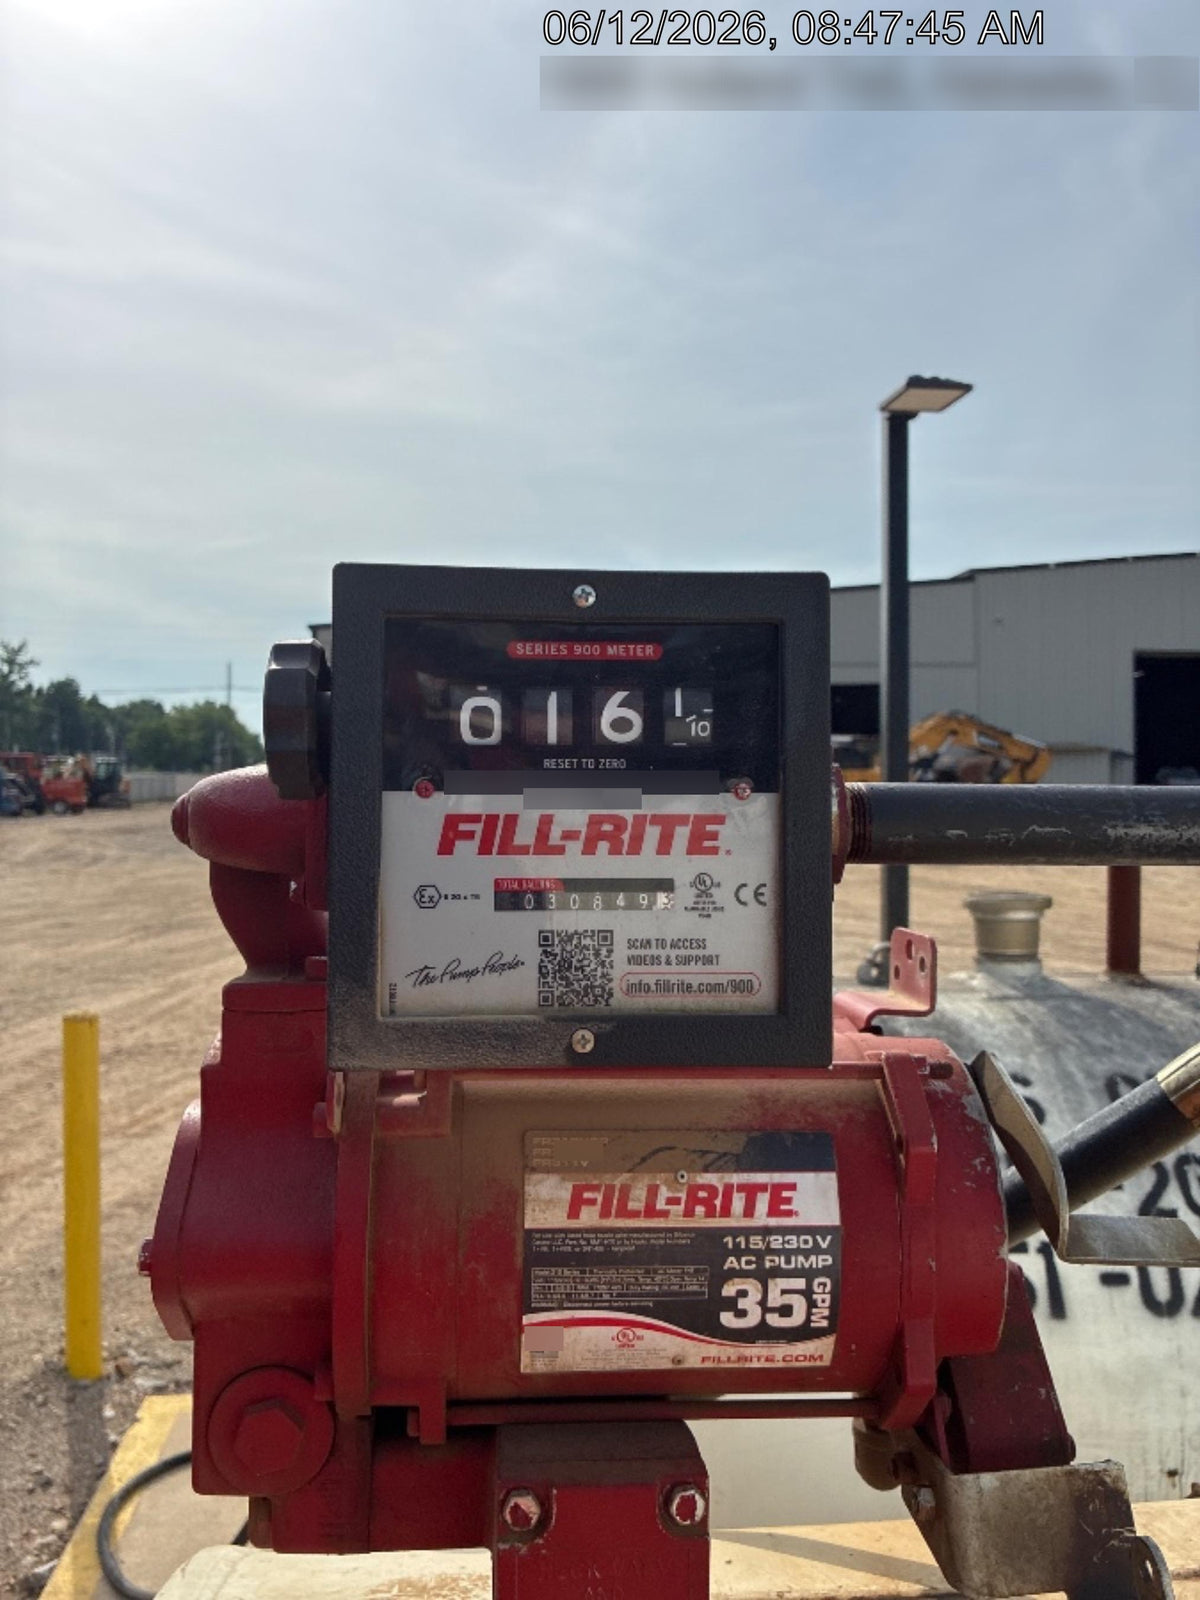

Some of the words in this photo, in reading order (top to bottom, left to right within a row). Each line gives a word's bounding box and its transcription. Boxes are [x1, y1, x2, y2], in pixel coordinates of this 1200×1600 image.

[516, 643, 568, 655] SERIES
[573, 644, 600, 656] 900
[606, 644, 655, 657] METER
[543, 758, 578, 769] RESET
[581, 758, 595, 769] TO
[598, 759, 626, 769] ZERO
[436, 813, 727, 857] FILL-RITE
[734, 882, 768, 907] CE
[626, 938, 652, 950] SCAN
[655, 938, 668, 950] TO
[669, 938, 707, 950] ACCESS
[626, 954, 662, 966] VIDEOS
[664, 954, 673, 966] &
[675, 954, 720, 966] SUPPORT
[405, 964, 439, 988] The
[625, 978, 754, 994] info.fillrite.com/900
[566, 1181, 798, 1220] FILL-RITE
[722, 1234, 814, 1251] 115/230
[815, 1234, 833, 1249] V
[722, 1256, 757, 1270] AC
[764, 1254, 833, 1269] PUMP
[719, 1277, 808, 1329] 35
[810, 1276, 832, 1328] GPM
[700, 1353, 825, 1365] FILLRITE.COM
